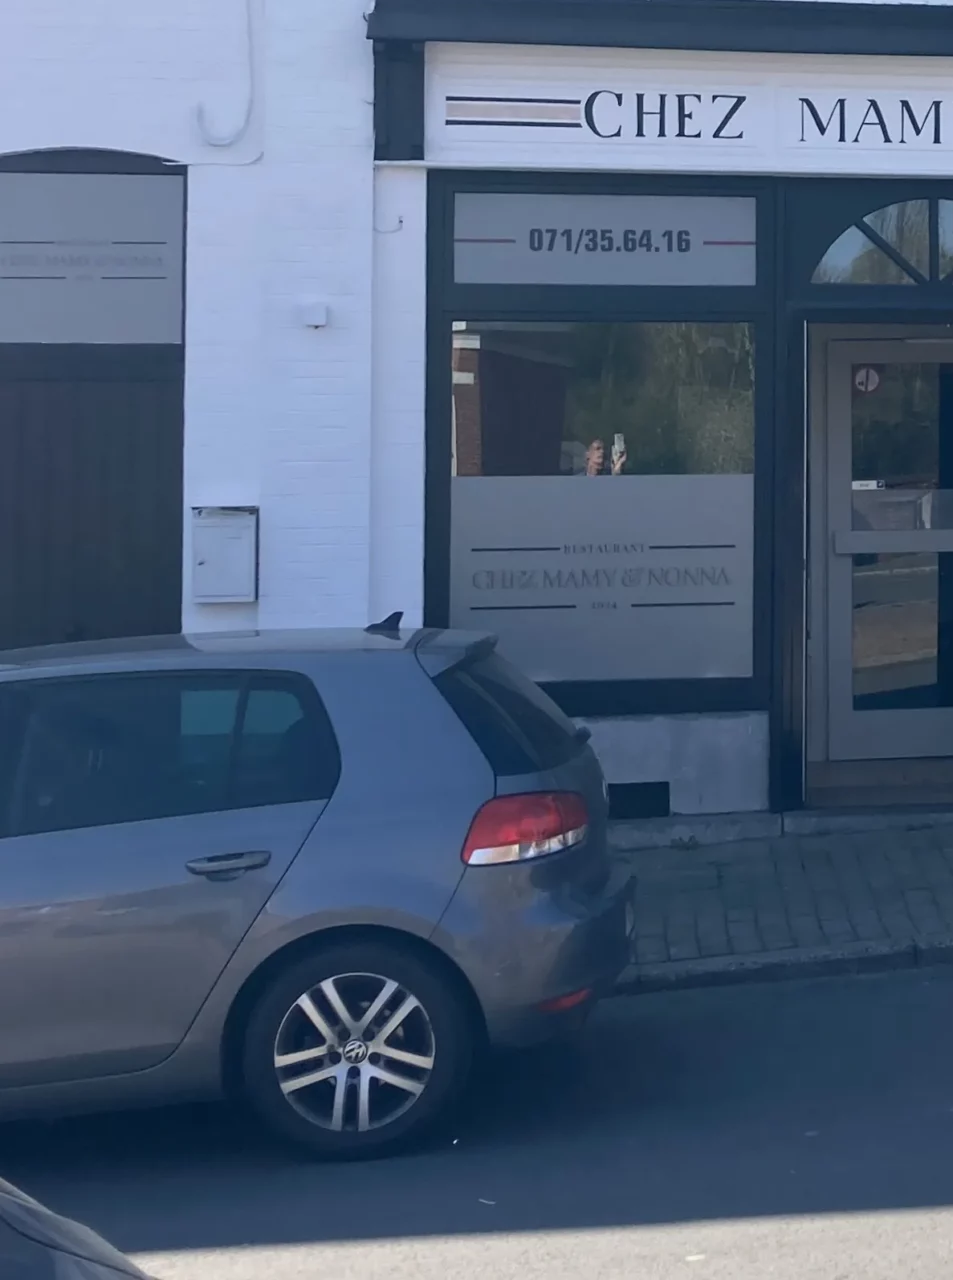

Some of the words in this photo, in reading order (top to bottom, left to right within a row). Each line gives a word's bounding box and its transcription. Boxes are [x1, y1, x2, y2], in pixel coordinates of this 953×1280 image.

[584, 90, 747, 140] CHEZ
[528, 228, 692, 254] 071/35.64.16
[563, 543, 645, 555] RESTAURANT
[542, 569, 619, 589] MAMY
[646, 567, 732, 587] NONNA
